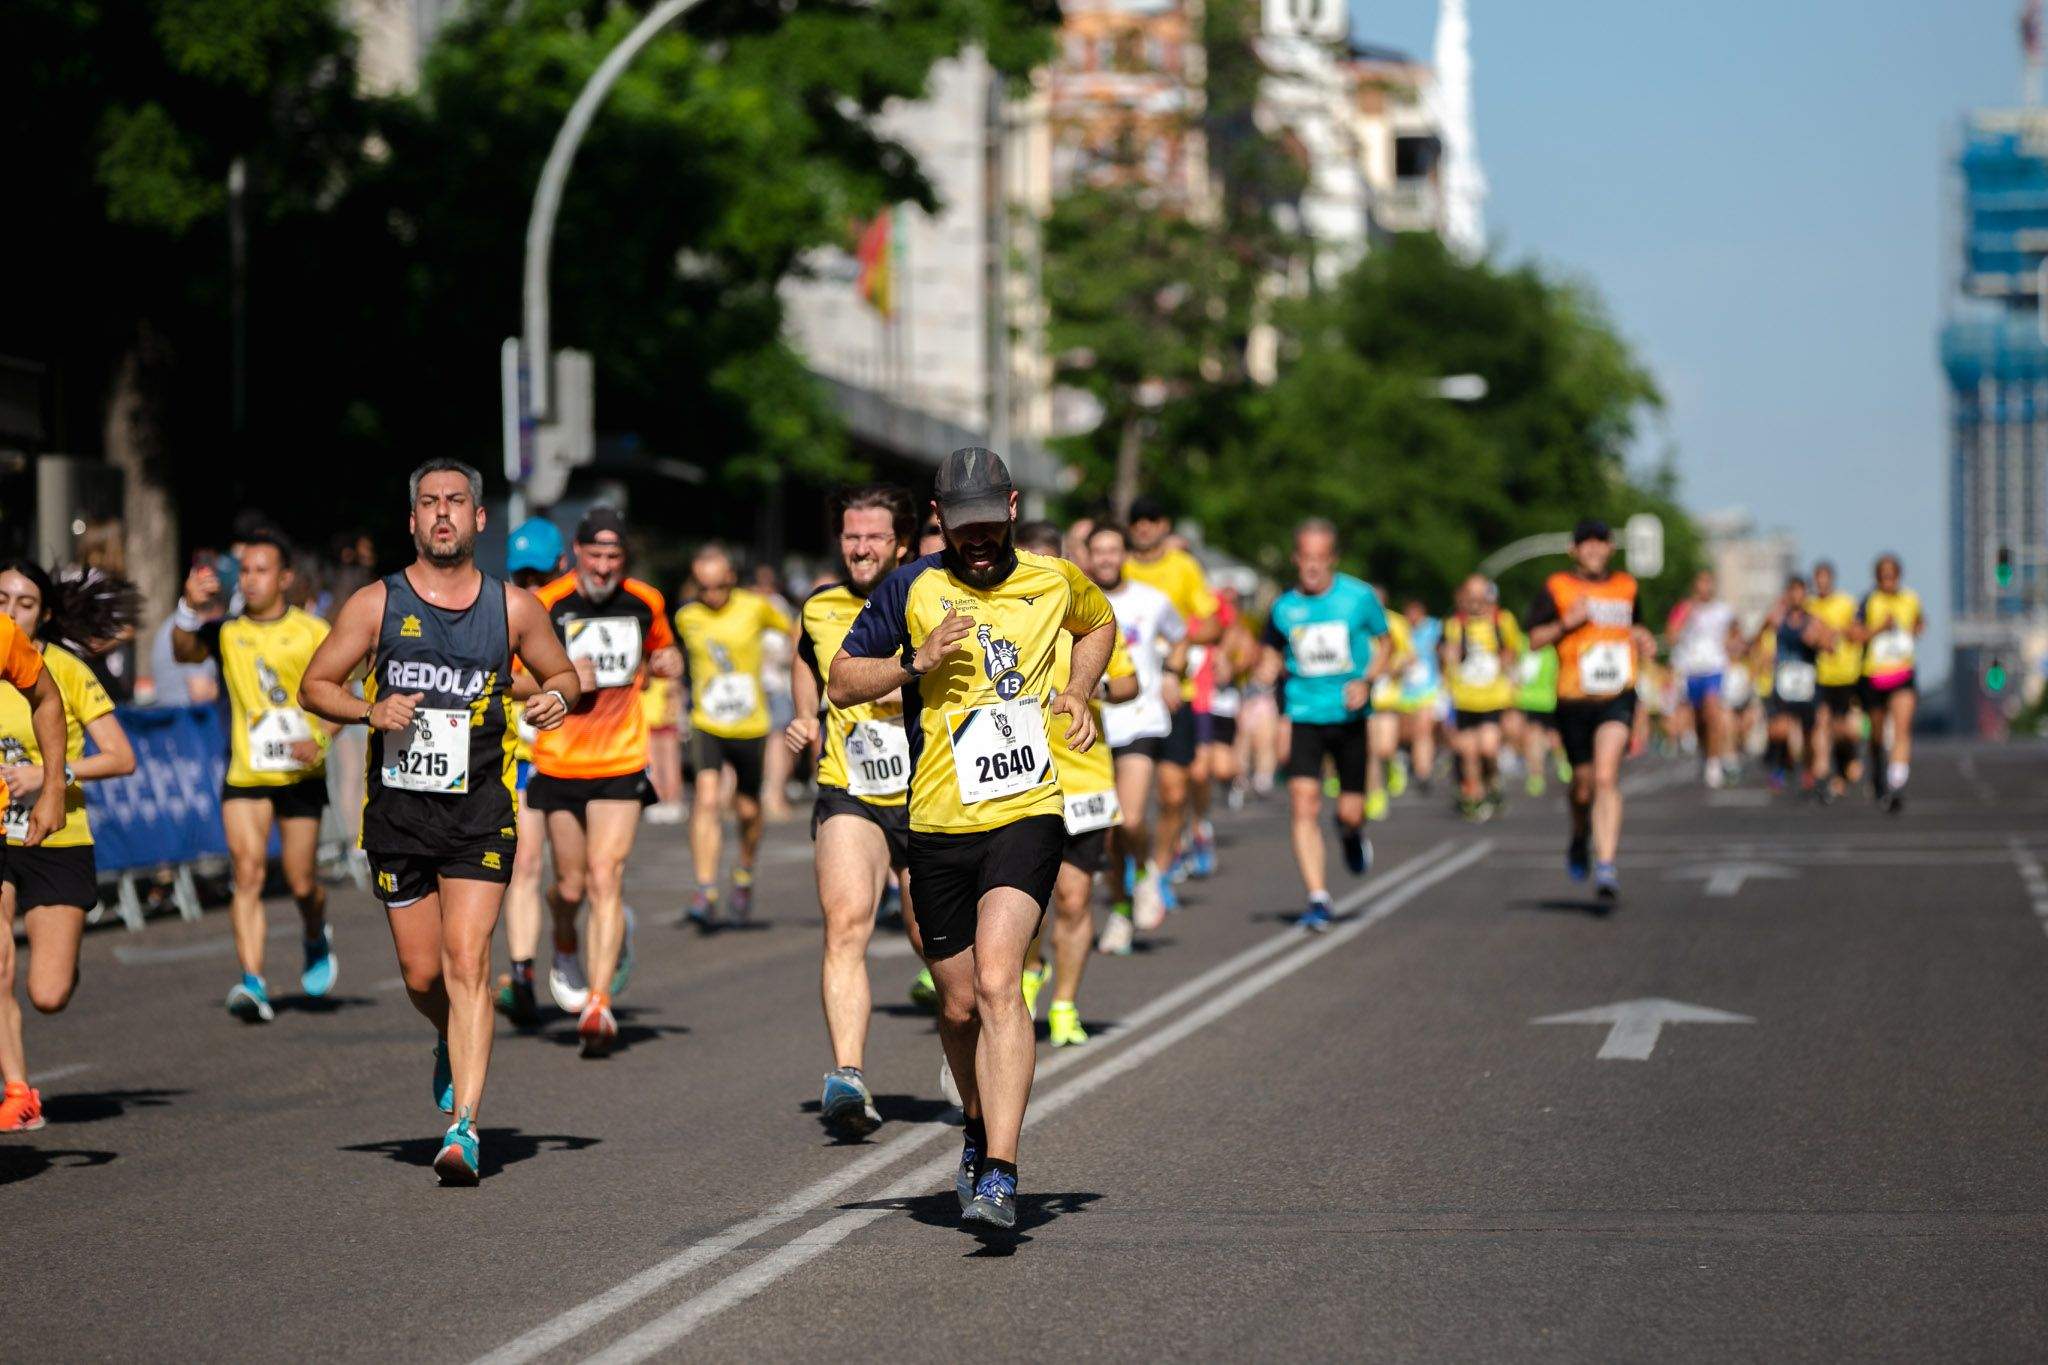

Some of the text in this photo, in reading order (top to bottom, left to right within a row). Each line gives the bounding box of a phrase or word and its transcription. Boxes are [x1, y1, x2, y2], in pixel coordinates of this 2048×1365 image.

[388, 660, 489, 697] REDOLA
[1002, 678, 1020, 694] 13
[398, 749, 448, 777] 3215
[862, 755, 902, 779] 1700
[976, 745, 1035, 783] 2640
